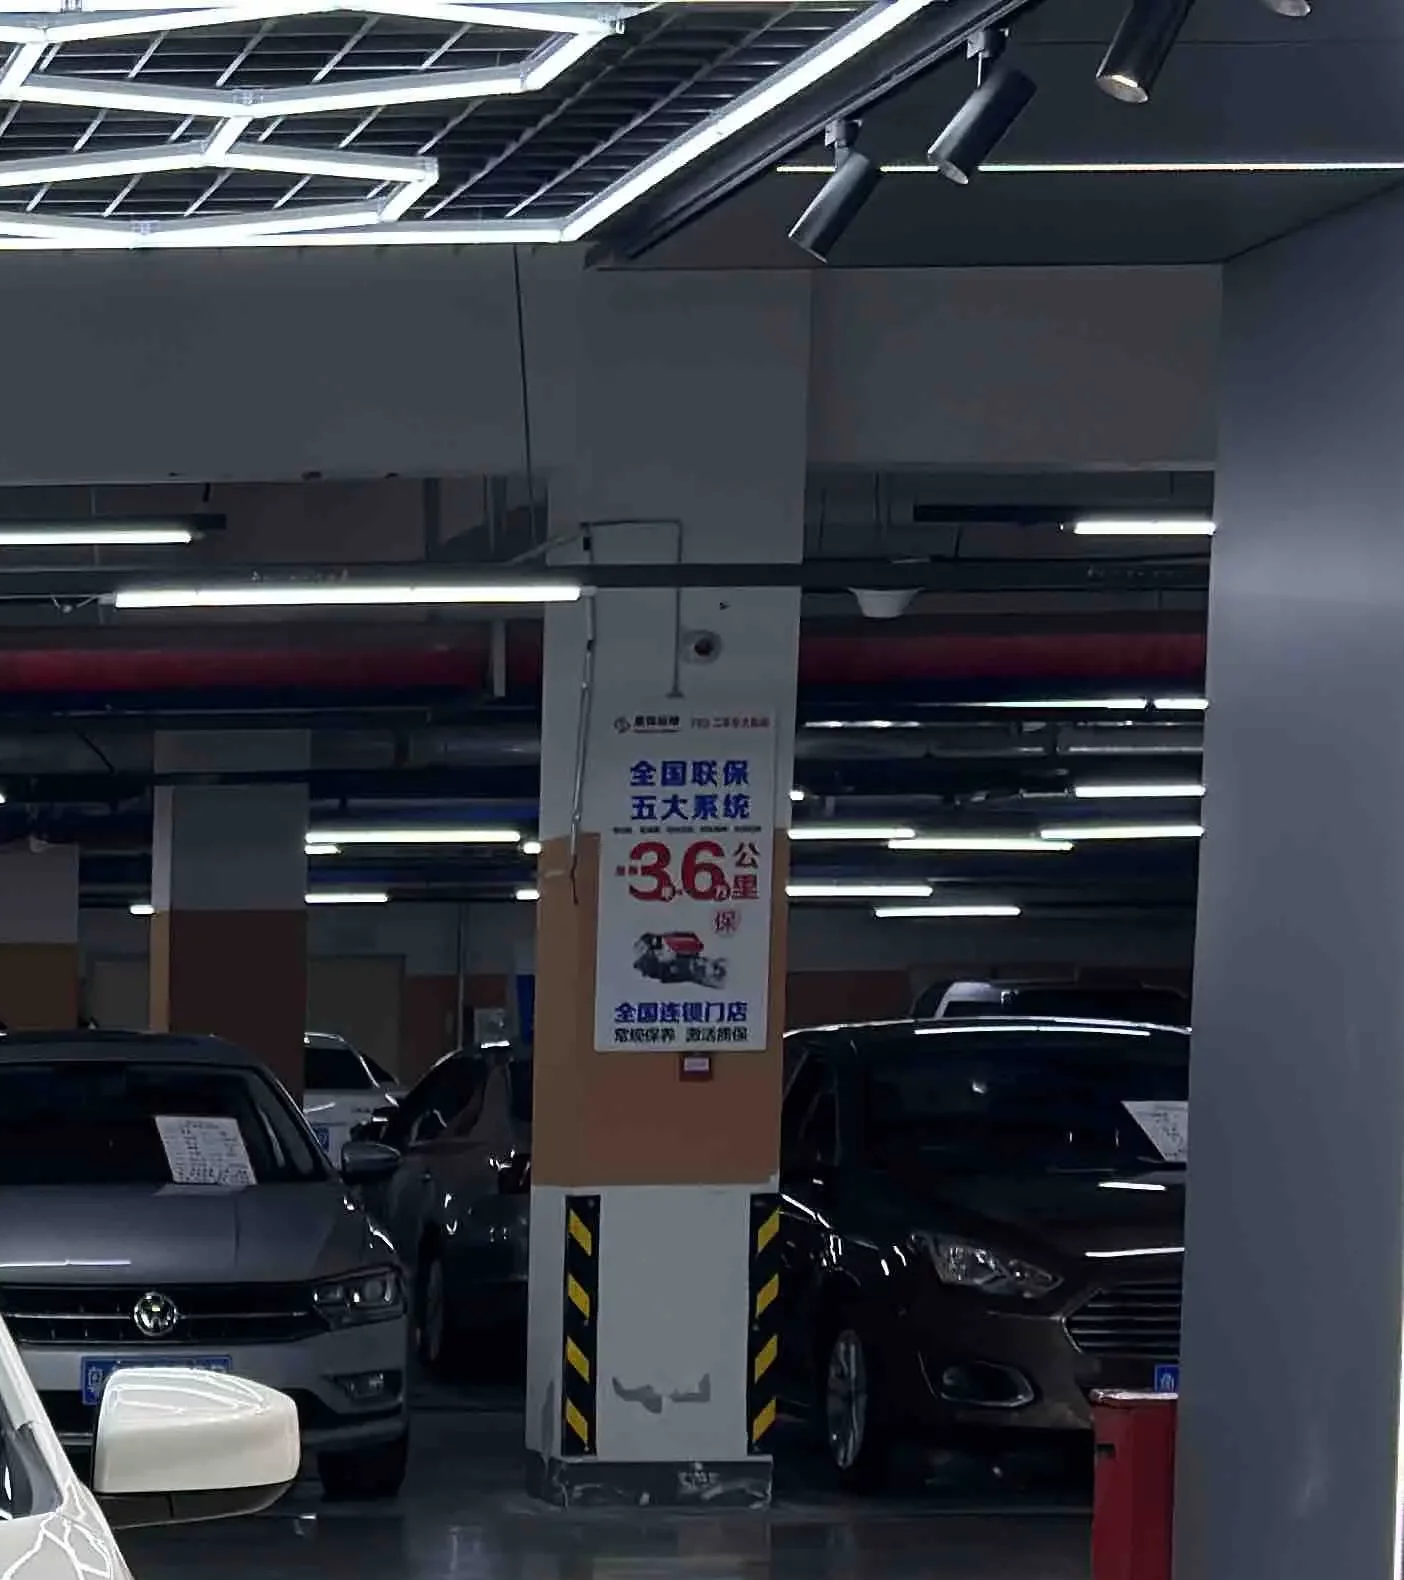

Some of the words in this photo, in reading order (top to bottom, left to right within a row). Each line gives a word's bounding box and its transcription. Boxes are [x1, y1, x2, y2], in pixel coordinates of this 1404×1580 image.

[629, 760, 749, 787] 全国联保
[630, 793, 751, 820] 五大系统
[614, 1001, 748, 1024] 全国连锁门店
